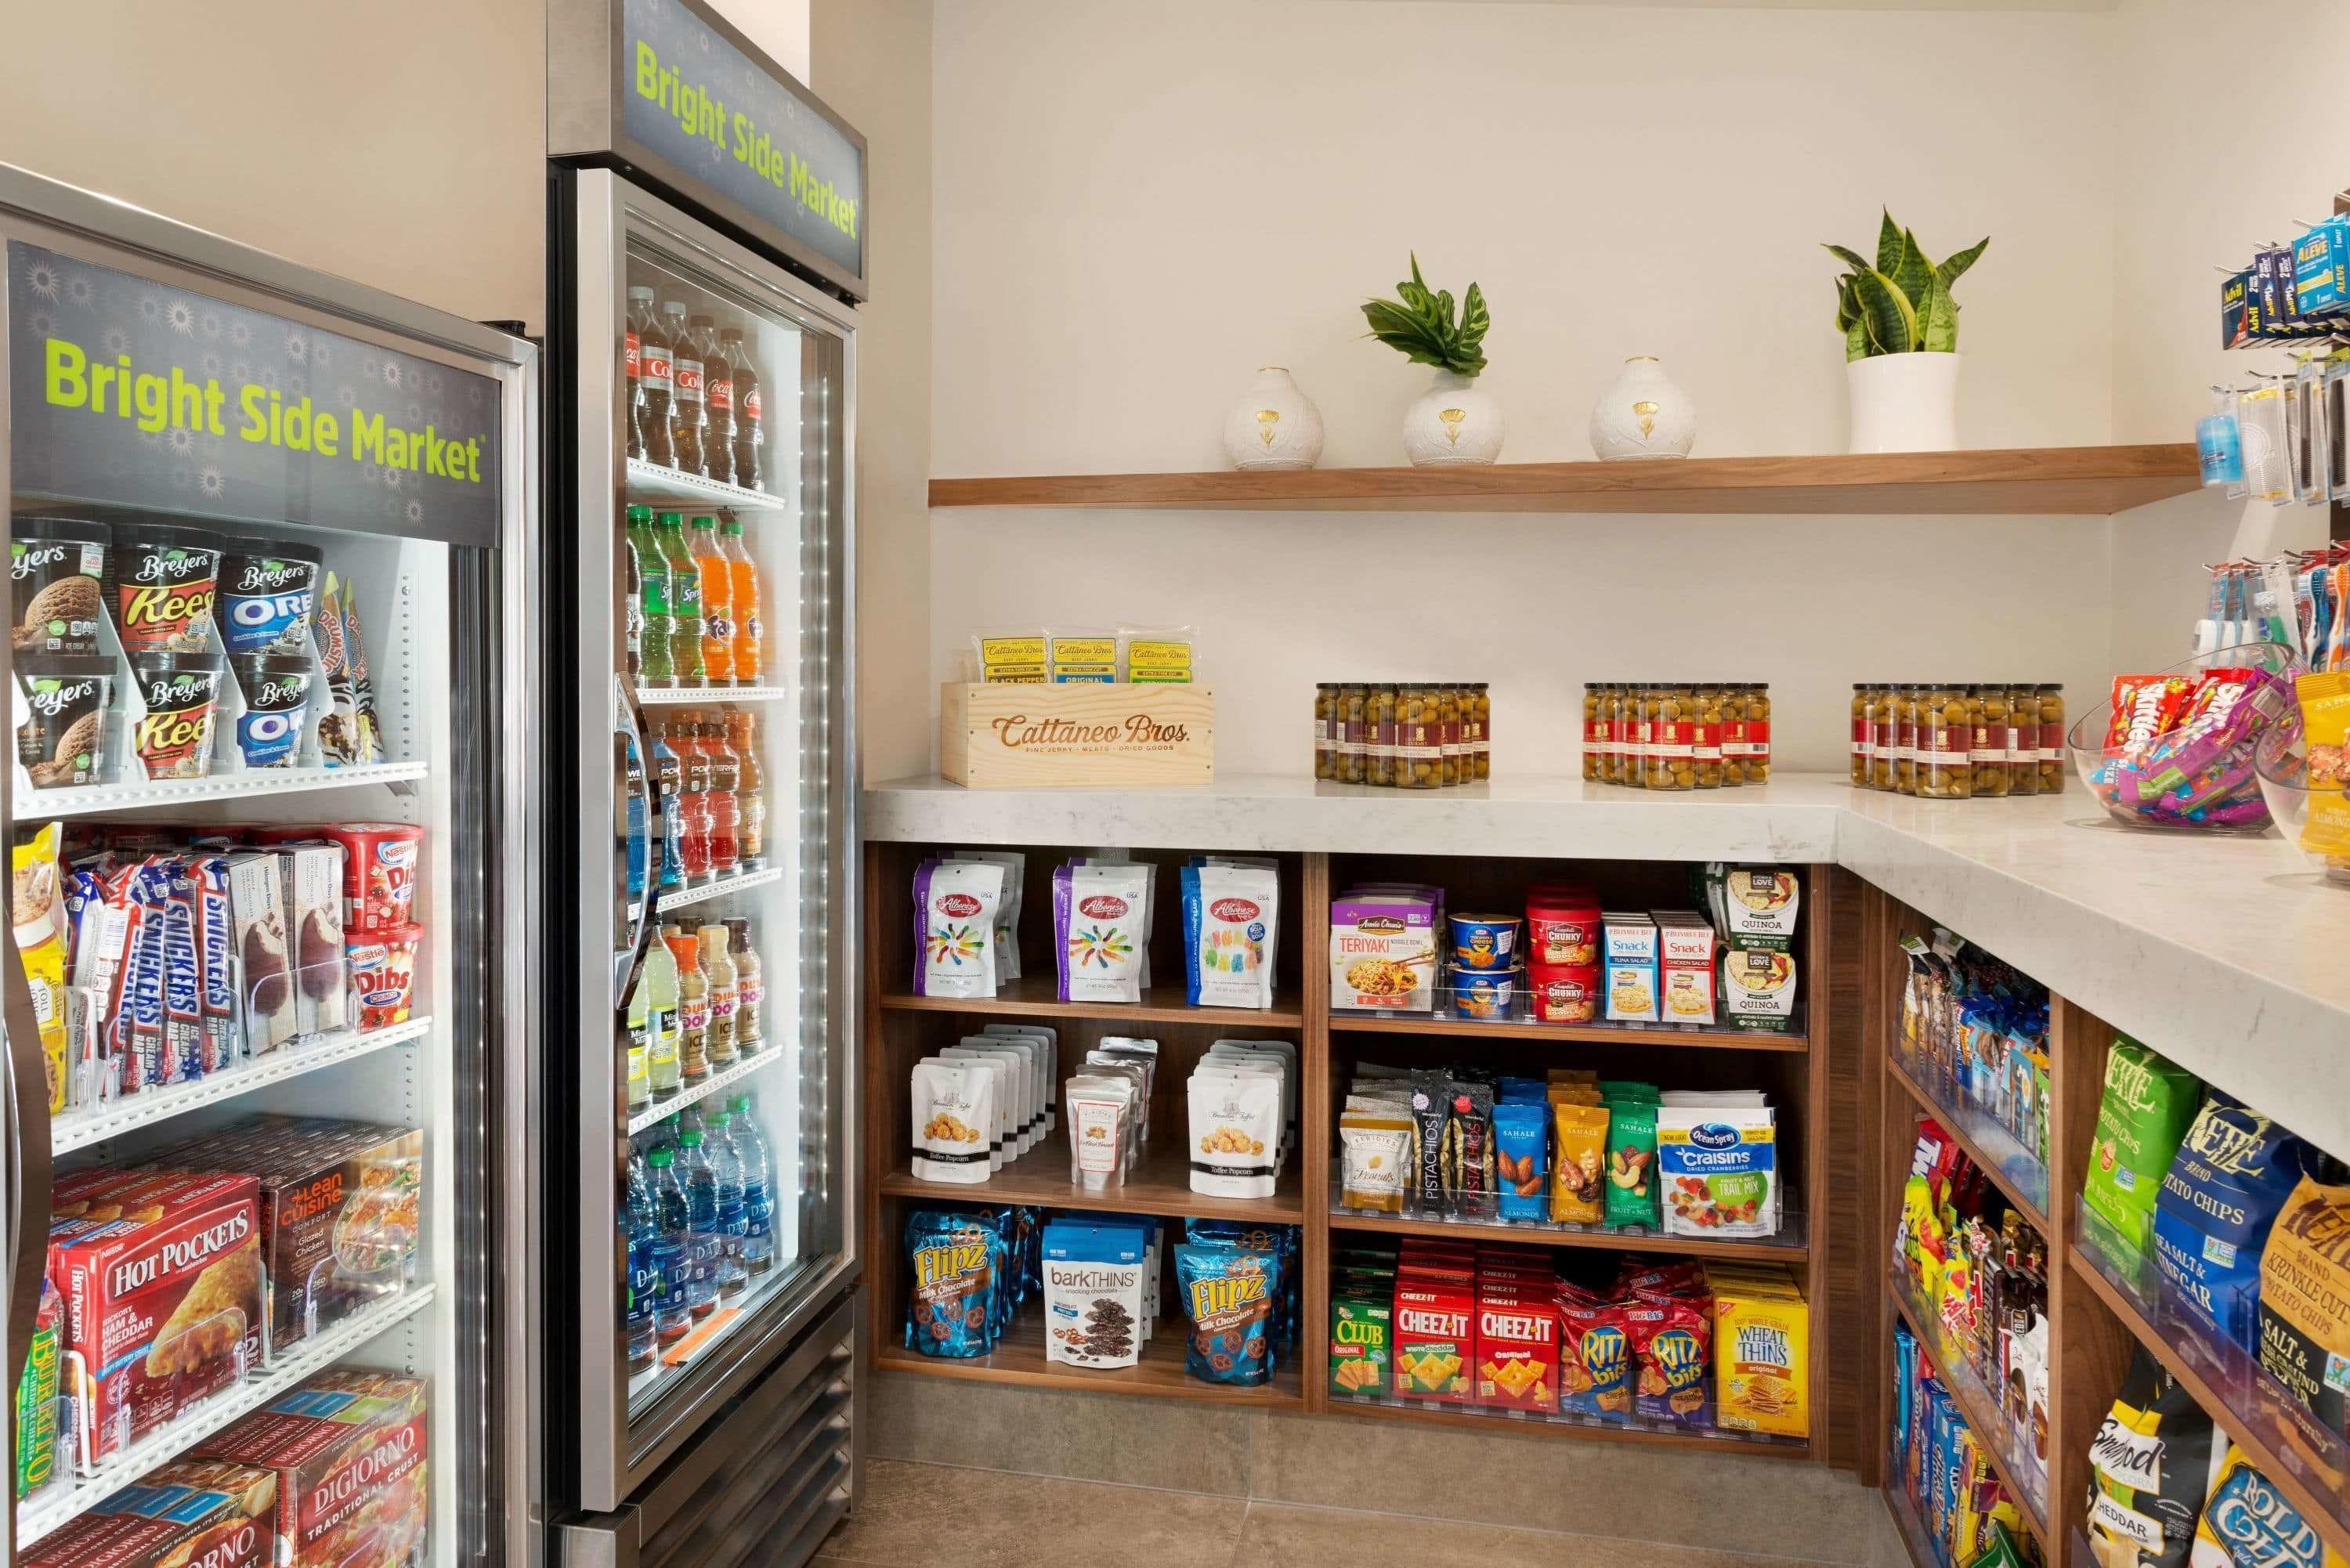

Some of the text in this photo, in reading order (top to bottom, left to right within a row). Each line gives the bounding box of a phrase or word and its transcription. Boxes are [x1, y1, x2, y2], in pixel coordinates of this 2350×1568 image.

[637, 38, 857, 240] Bright Side Market
[2297, 240, 2330, 264] ALEVE
[2336, 263, 2346, 294] ALEVE
[2248, 306, 2260, 334] Advil
[45, 337, 481, 482] Bright Side Market
[136, 553, 208, 581] Breyers
[237, 565, 307, 590] Breyers
[1015, 674, 1047, 684] PEPPER
[2124, 683, 2166, 753] Skittles
[991, 714, 1191, 748] Cattaneo Bros.
[939, 898, 978, 912] Albanese
[1085, 899, 1125, 913] Albanese
[1214, 901, 1256, 916] Albanese
[1359, 918, 1405, 930] Annie Chun's
[1612, 928, 1639, 937] BUMBLE
[1669, 930, 1710, 939] BUMBLE BEE
[1741, 919, 1783, 930] QUINOA
[1339, 937, 1390, 954] TERIYAKI
[1548, 931, 1582, 942] CHUNKY
[1613, 939, 1650, 952] Snack
[207, 895, 231, 1008] SNICKERS
[1669, 941, 1706, 955] Snack
[132, 910, 164, 1032] SNICKERS
[164, 904, 198, 1016] SNICKERS
[354, 966, 410, 995] Dibs
[371, 991, 399, 1003] CRUNCH
[1548, 988, 1583, 999] CHUNKY
[1739, 1000, 1781, 1010] QUINOA
[167, 1020, 179, 1042] BAR
[178, 1021, 191, 1058] CREAM
[1502, 1129, 1536, 1138] SAHALE
[1566, 1128, 1600, 1136] SAHALE
[1619, 1123, 1654, 1134] SAHALE
[1692, 1130, 1735, 1146] Ocean Spray
[2119, 1125, 2141, 1155] CHIPS
[945, 1154, 970, 1163] Popcorn
[1425, 1120, 1439, 1200] PISTACHIOS
[1466, 1122, 1481, 1201] PISTACHIOS
[1682, 1151, 1751, 1167] Craisins
[1209, 1166, 1254, 1176] Toffee Popcorn
[1353, 1169, 1395, 1183] Peanuts
[2184, 1161, 2211, 1182] BRAND
[1718, 1181, 1759, 1197] TRAIL MIX
[1503, 1209, 1540, 1218] ALMONDS
[1560, 1209, 1596, 1218] ALMONDS
[2193, 1190, 2245, 1226] CHIPS
[291, 1209, 331, 1234] COMFORT
[298, 1227, 324, 1246] Glazed
[114, 1208, 249, 1298] HOT POCKETS
[295, 1239, 326, 1258] Chicken
[2154, 1231, 2171, 1255] SEA
[2171, 1245, 2196, 1272] SALT
[2195, 1263, 2207, 1281] &
[913, 1241, 989, 1292] Flipz
[1050, 1266, 1135, 1288] barkTHINS
[2296, 1250, 2331, 1282] BRAND
[937, 1277, 977, 1294] Chocolate
[1482, 1284, 1517, 1294] CHEEZ-IT
[2155, 1249, 2215, 1313] VINEGAR
[2265, 1251, 2350, 1324] KRINKLE CUT
[1189, 1274, 1267, 1321] Flipz
[1400, 1292, 1437, 1302] CHEEZ-IT
[1481, 1297, 1518, 1306] CHEEZ-IT
[1654, 1296, 1672, 1306] BAG
[103, 1311, 139, 1336] HAM &
[1215, 1308, 1254, 1328] Chocolate
[1398, 1308, 1469, 1338] CHEEZ-IT
[1578, 1310, 1596, 1319] BAG
[1628, 1310, 1664, 1321] BIG BAG
[1748, 1317, 1769, 1327] WHOLE
[1769, 1319, 1791, 1330] GRAIN
[2301, 1303, 2334, 1336] CHIPS
[102, 1316, 154, 1351] CHEDDAR
[1336, 1320, 1383, 1345] CLUB
[1480, 1312, 1553, 1342] CHEEZ-IT
[1735, 1326, 1788, 1346] WHEAT
[1335, 1346, 1360, 1355] ORIGINAL
[1425, 1344, 1455, 1353] cheddar
[1582, 1331, 1628, 1370] RITZ
[1652, 1334, 1701, 1371] RITZ
[2262, 1317, 2308, 1371] SALT &
[1592, 1360, 1631, 1386] bits
[1665, 1365, 1702, 1389] bits
[1748, 1365, 1777, 1375] original
[27, 1338, 56, 1483] BURRITO
[237, 1419, 300, 1458] DIGIORNO
[273, 1424, 336, 1463] DIGIORNO
[313, 1425, 416, 1515] DIGIORNO
[306, 1451, 419, 1542] TRADITIONAL CRUST
[2098, 1497, 2148, 1537] HEDDAR
[2243, 1471, 2319, 1560] ROLD
[1975, 1533, 1987, 1550] FIG
